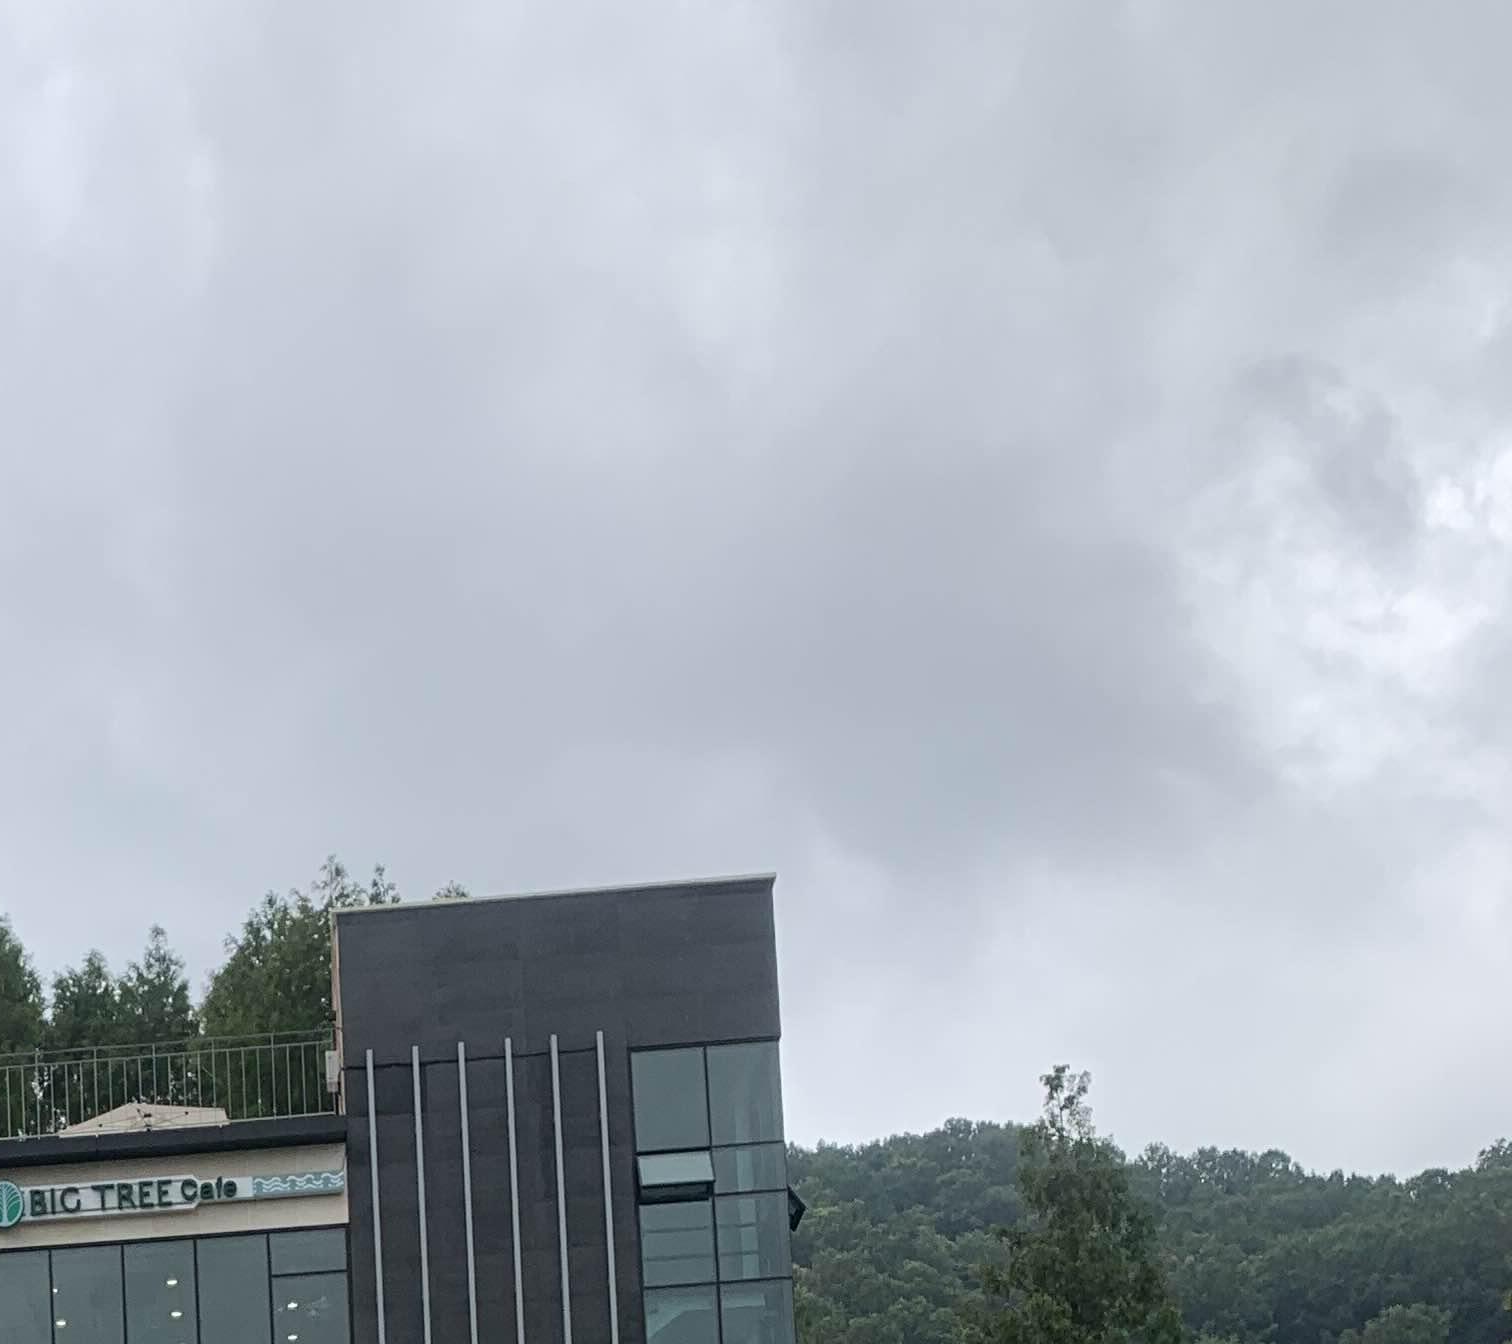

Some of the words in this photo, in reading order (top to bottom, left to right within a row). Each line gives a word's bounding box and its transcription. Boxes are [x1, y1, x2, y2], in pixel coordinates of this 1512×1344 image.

[29, 1186, 81, 1217] BIG
[91, 1179, 172, 1212] TREE
[180, 1176, 237, 1202] Cafe
